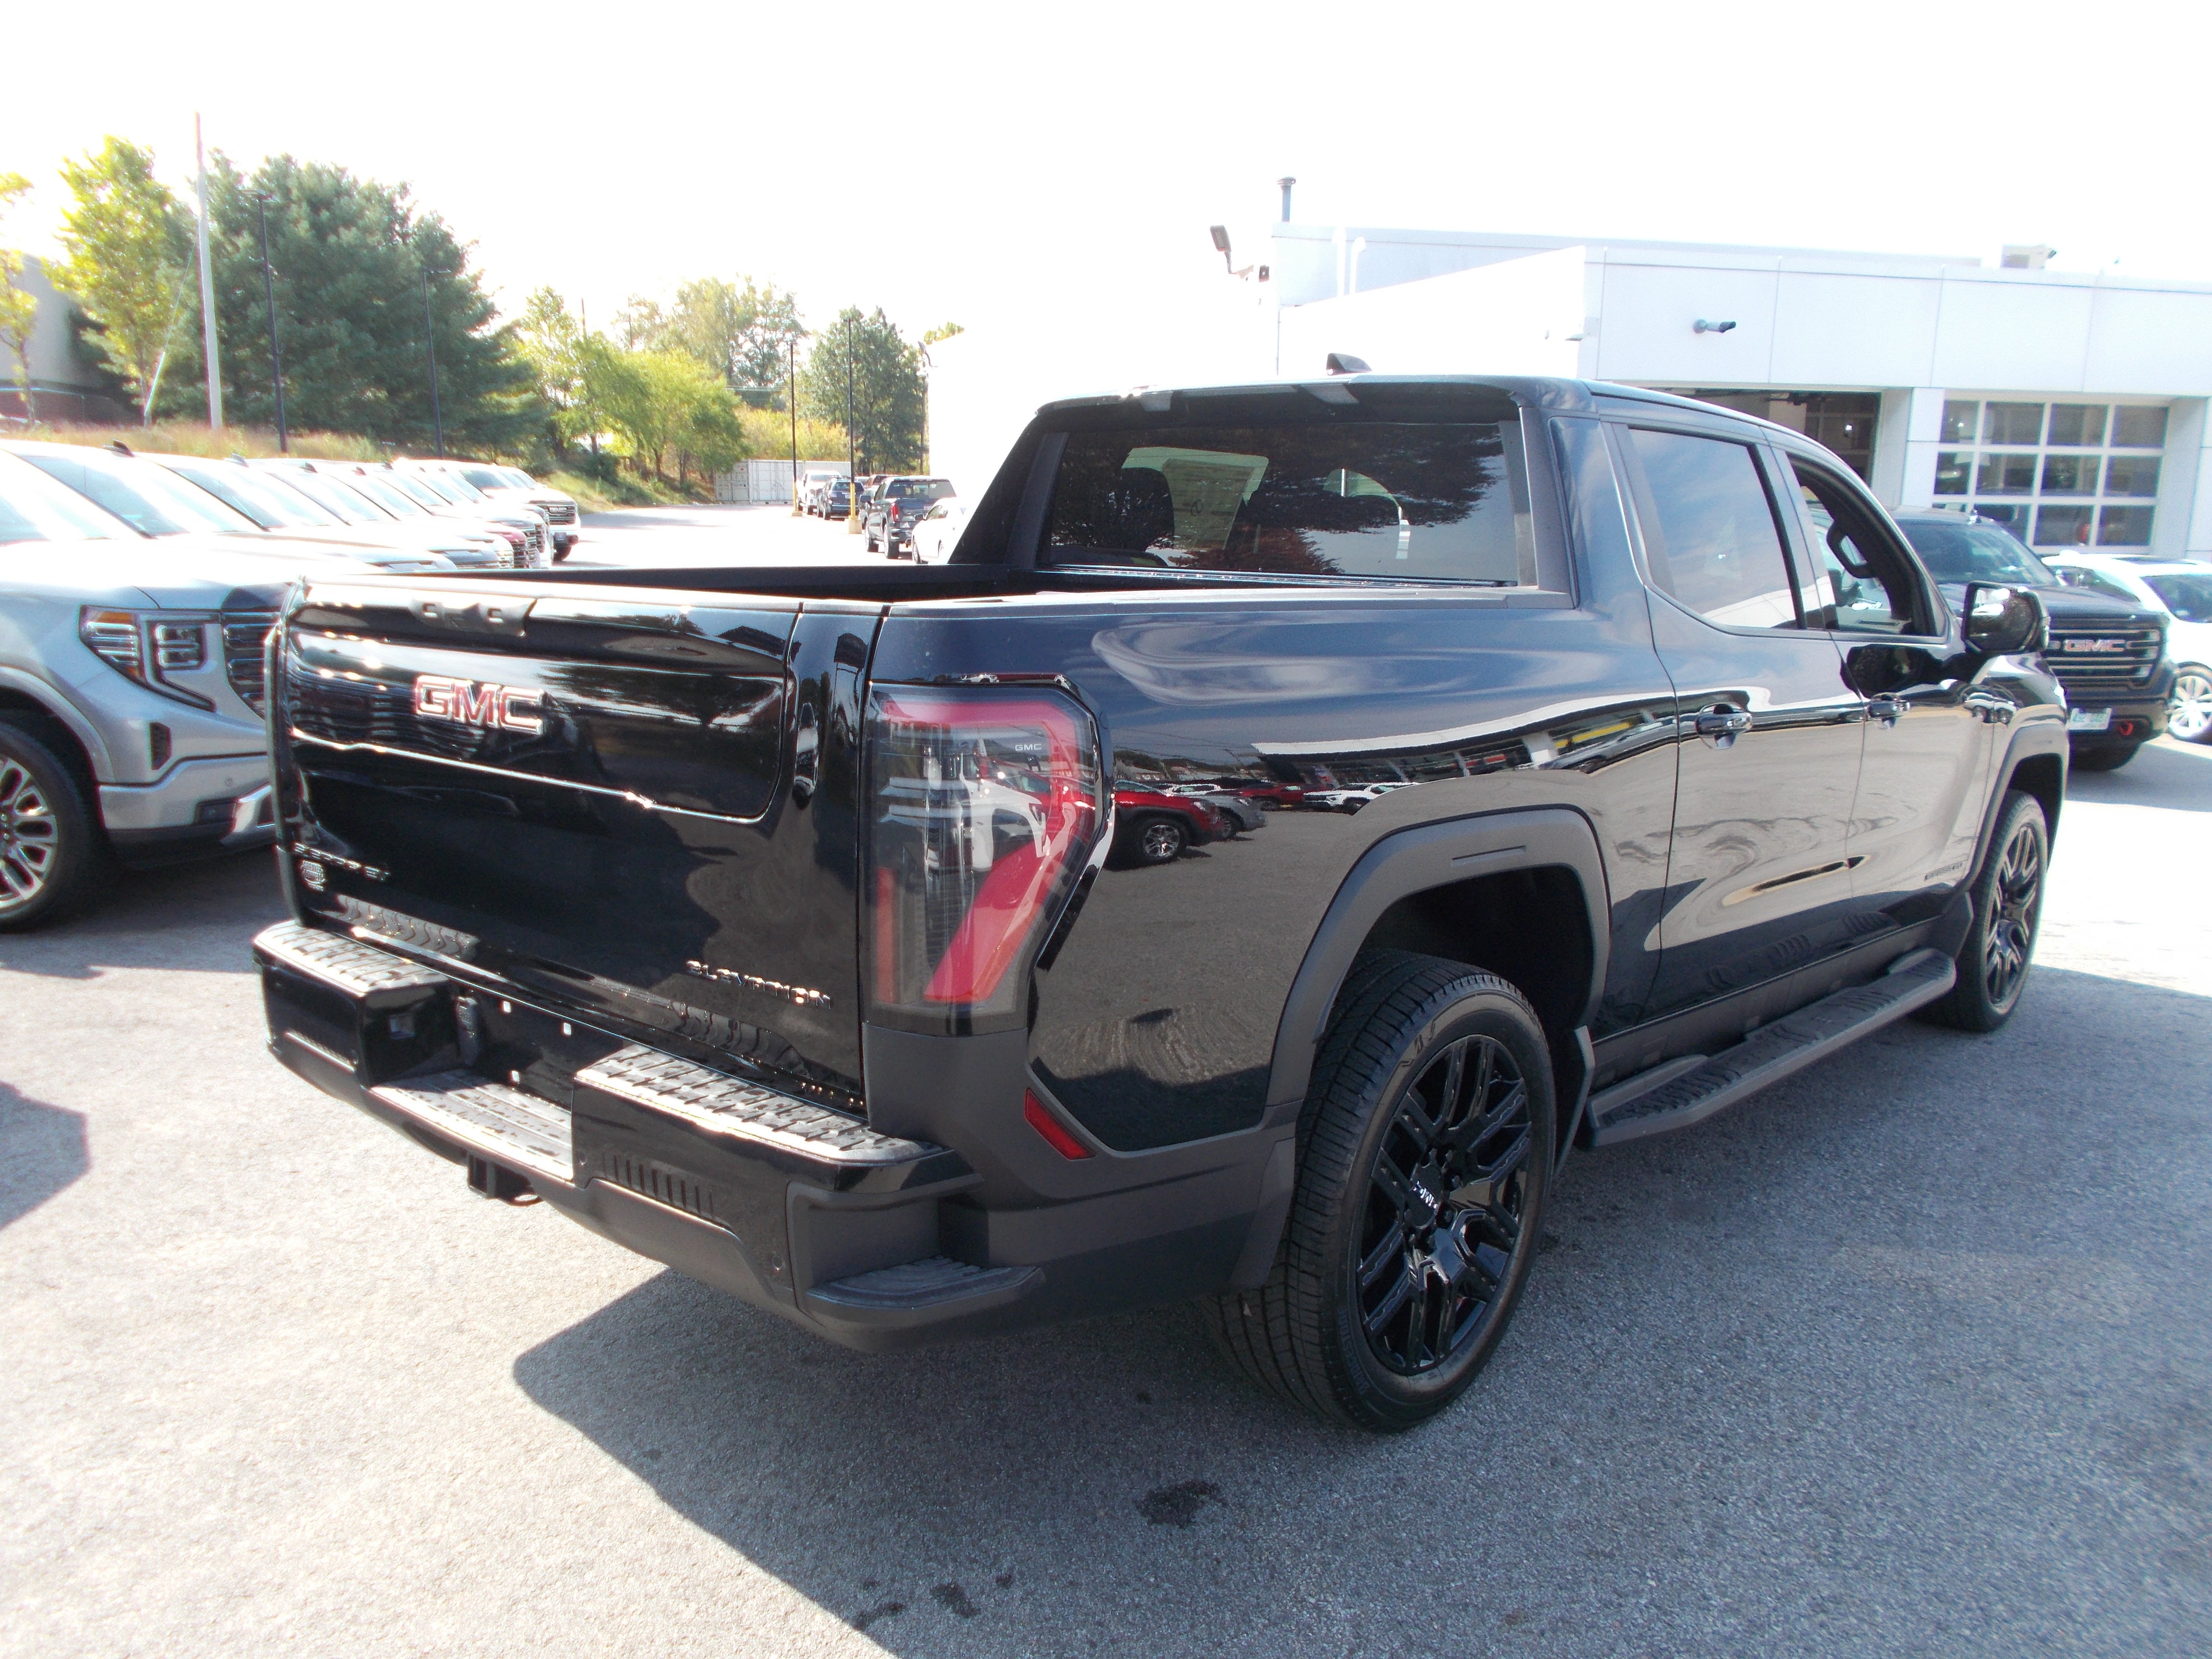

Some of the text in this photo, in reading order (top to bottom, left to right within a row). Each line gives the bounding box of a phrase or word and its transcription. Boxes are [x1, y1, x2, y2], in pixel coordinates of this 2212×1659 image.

[2065, 639, 2125, 652] GMC
[415, 675, 543, 735] GMC
[686, 960, 832, 1010] ELEVATION
